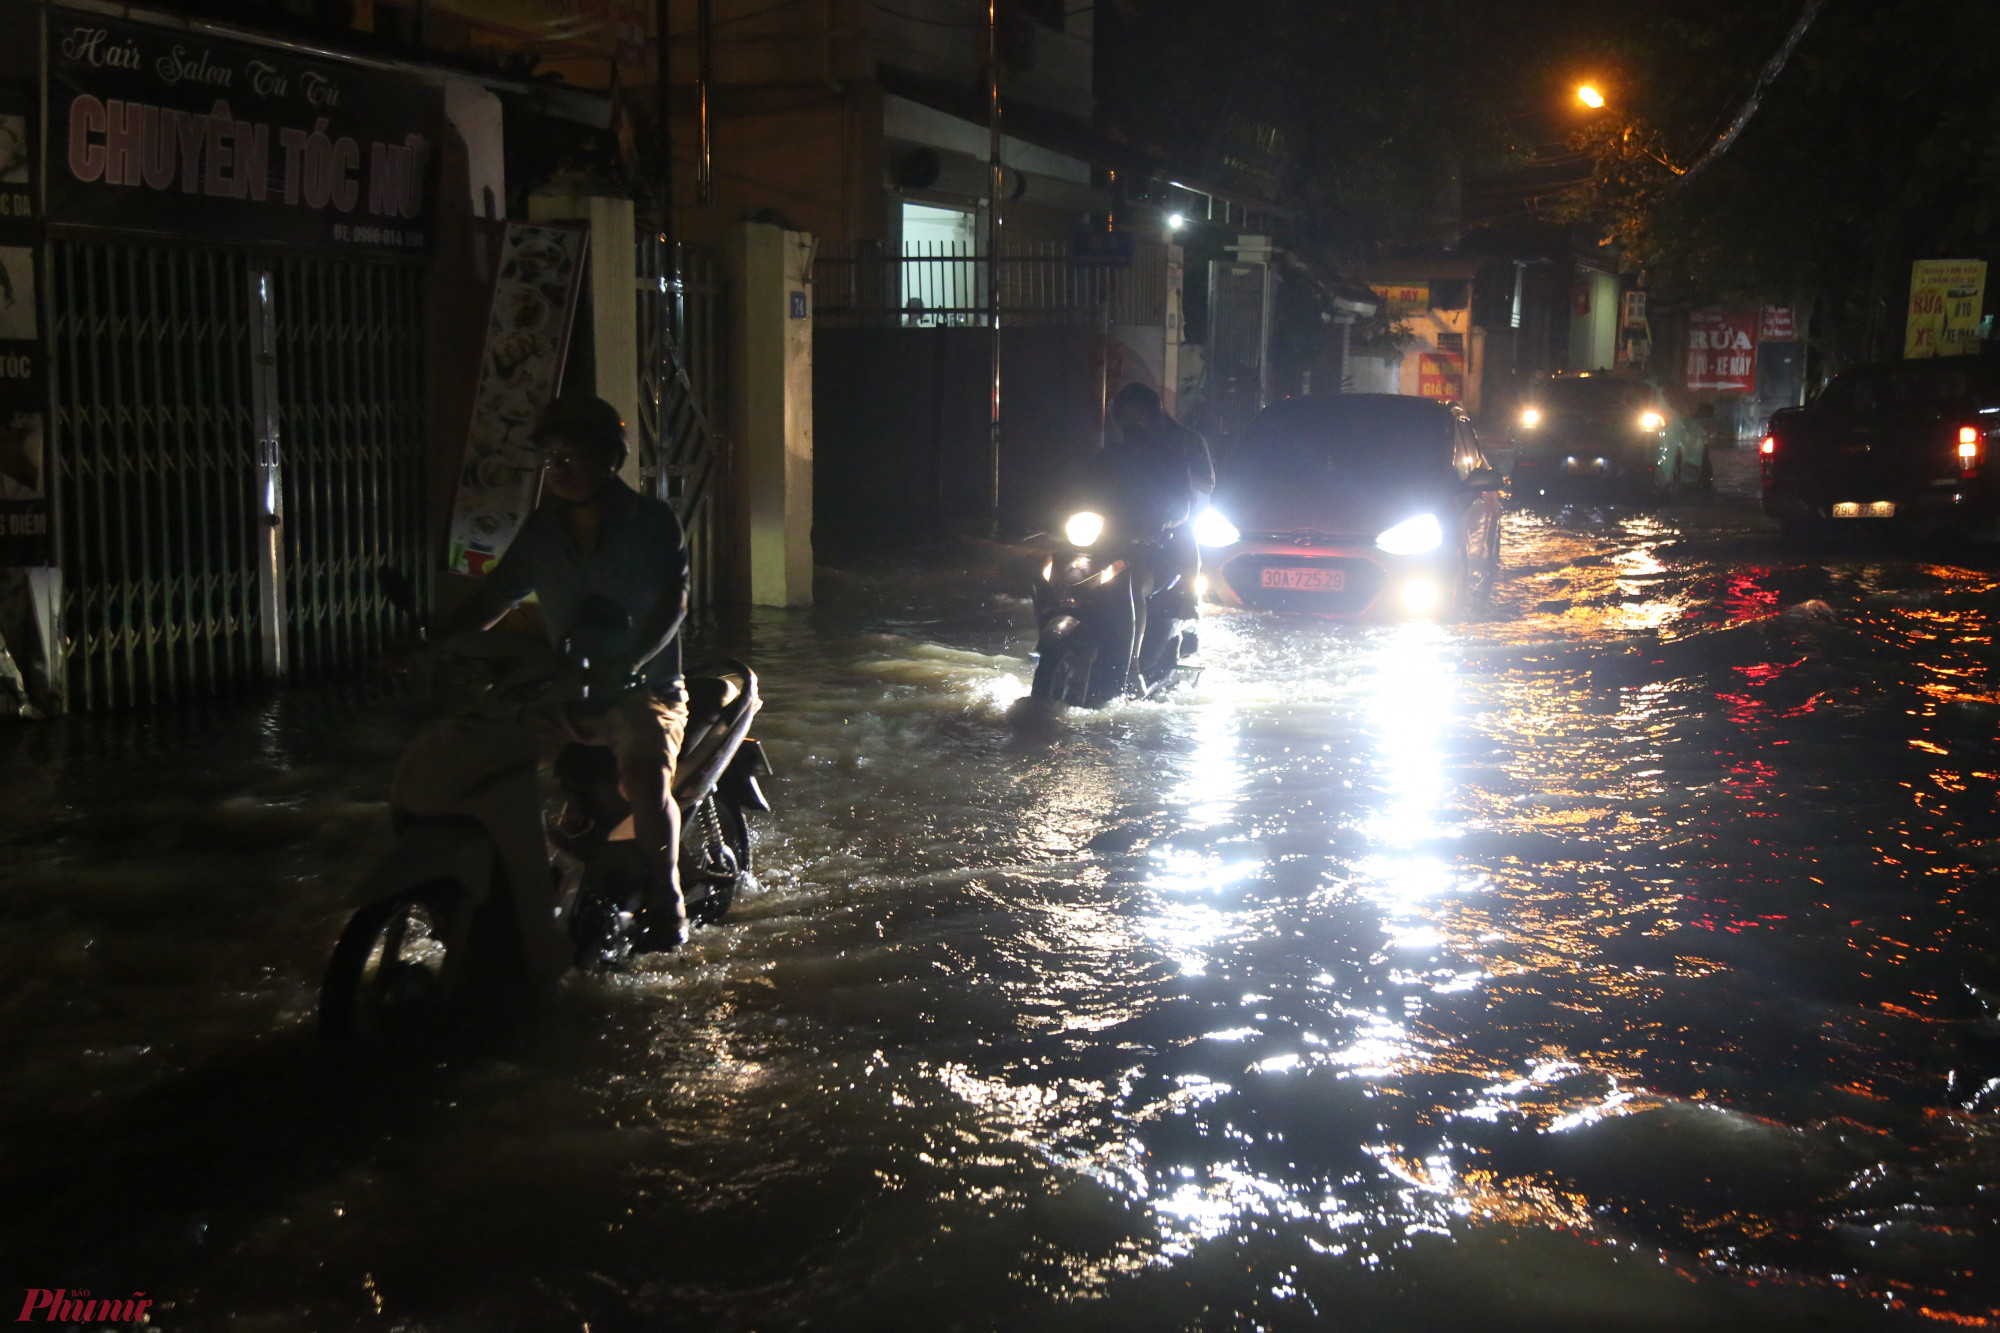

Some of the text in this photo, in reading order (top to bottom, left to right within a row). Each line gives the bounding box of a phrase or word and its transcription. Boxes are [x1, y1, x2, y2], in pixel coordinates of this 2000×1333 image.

[62, 27, 142, 70] Hair
[156, 44, 233, 88] Salon
[68, 93, 430, 219] CHUYÊN TÓC NỮ
[13, 194, 32, 217] DA
[793, 297, 805, 316] 74
[1689, 322, 1753, 350] RỬA
[1915, 328, 1934, 346] XE
[1716, 356, 1729, 375] XE
[1730, 352, 1752, 376] MÁY
